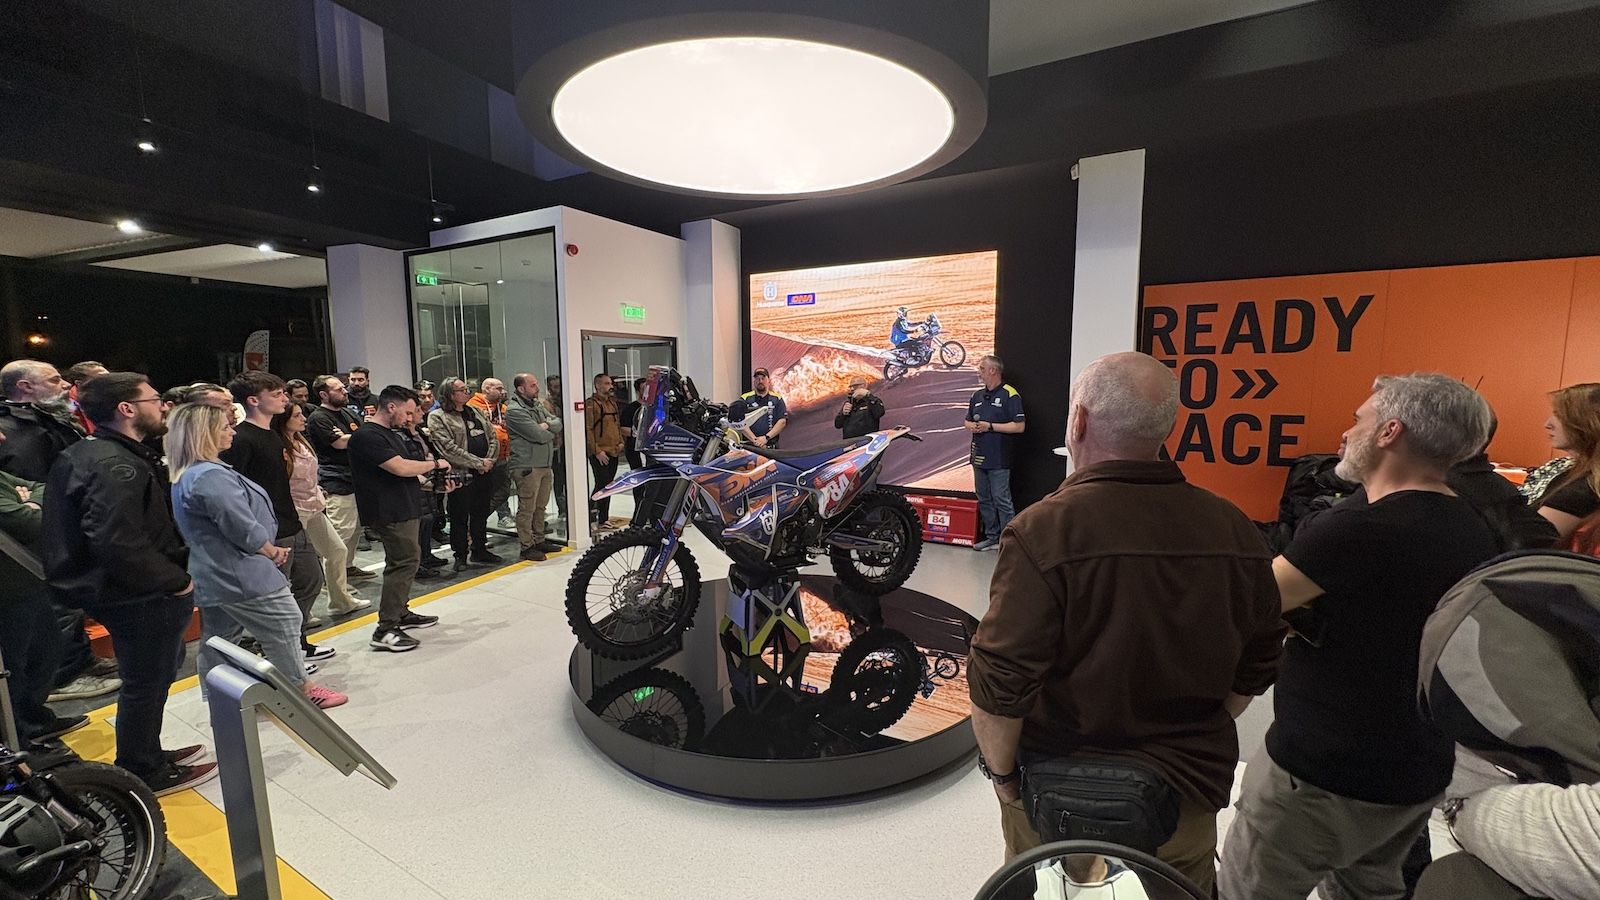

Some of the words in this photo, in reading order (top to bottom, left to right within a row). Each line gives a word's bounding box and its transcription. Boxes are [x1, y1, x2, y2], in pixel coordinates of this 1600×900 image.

[1142, 295, 1374, 355] READY
[1159, 358, 1218, 410] O
[1158, 413, 1305, 467] ACE
[905, 496, 924, 504] MOTUL
[932, 515, 945, 524] 84
[951, 537, 973, 546] MOTUL
